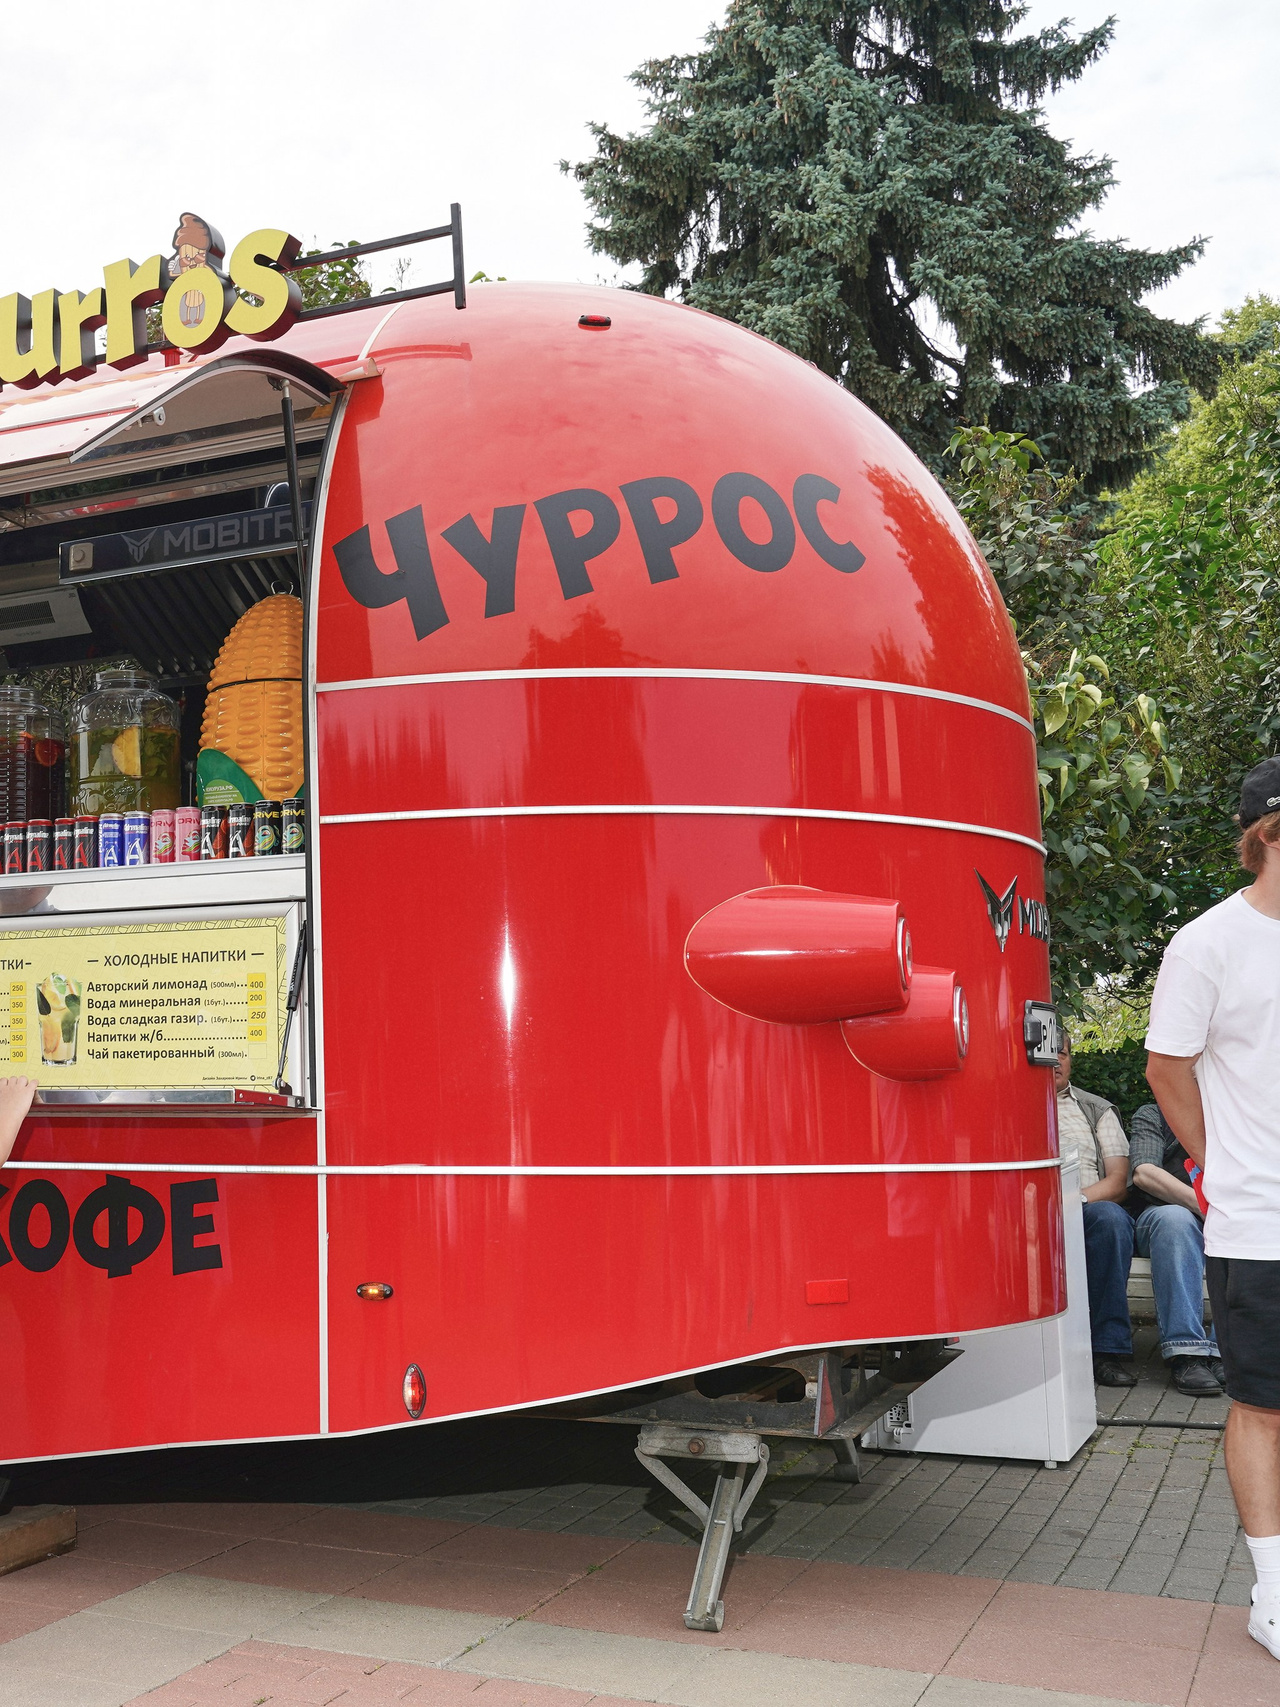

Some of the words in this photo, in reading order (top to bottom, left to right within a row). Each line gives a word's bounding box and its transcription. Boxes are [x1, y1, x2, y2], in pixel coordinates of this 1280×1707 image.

[332, 472, 866, 641] ЧУРРОС
[104, 953, 178, 968] ХОЛОДНЫЕ
[182, 950, 246, 963] НАПИТКИ
[87, 979, 149, 994] Авторский
[152, 980, 207, 990] лимонад
[249, 981, 264, 989] 400
[87, 998, 116, 1011] Вода
[119, 997, 201, 1009] минеральная
[87, 1015, 116, 1028] Вода
[119, 1015, 167, 1027] сладкая
[170, 1014, 208, 1026] газир.
[250, 1011, 266, 1019] 250
[87, 1032, 137, 1042] Напитки
[139, 1029, 164, 1043] ж/б
[87, 1048, 109, 1059] Чай
[112, 1046, 215, 1061] пакетированный
